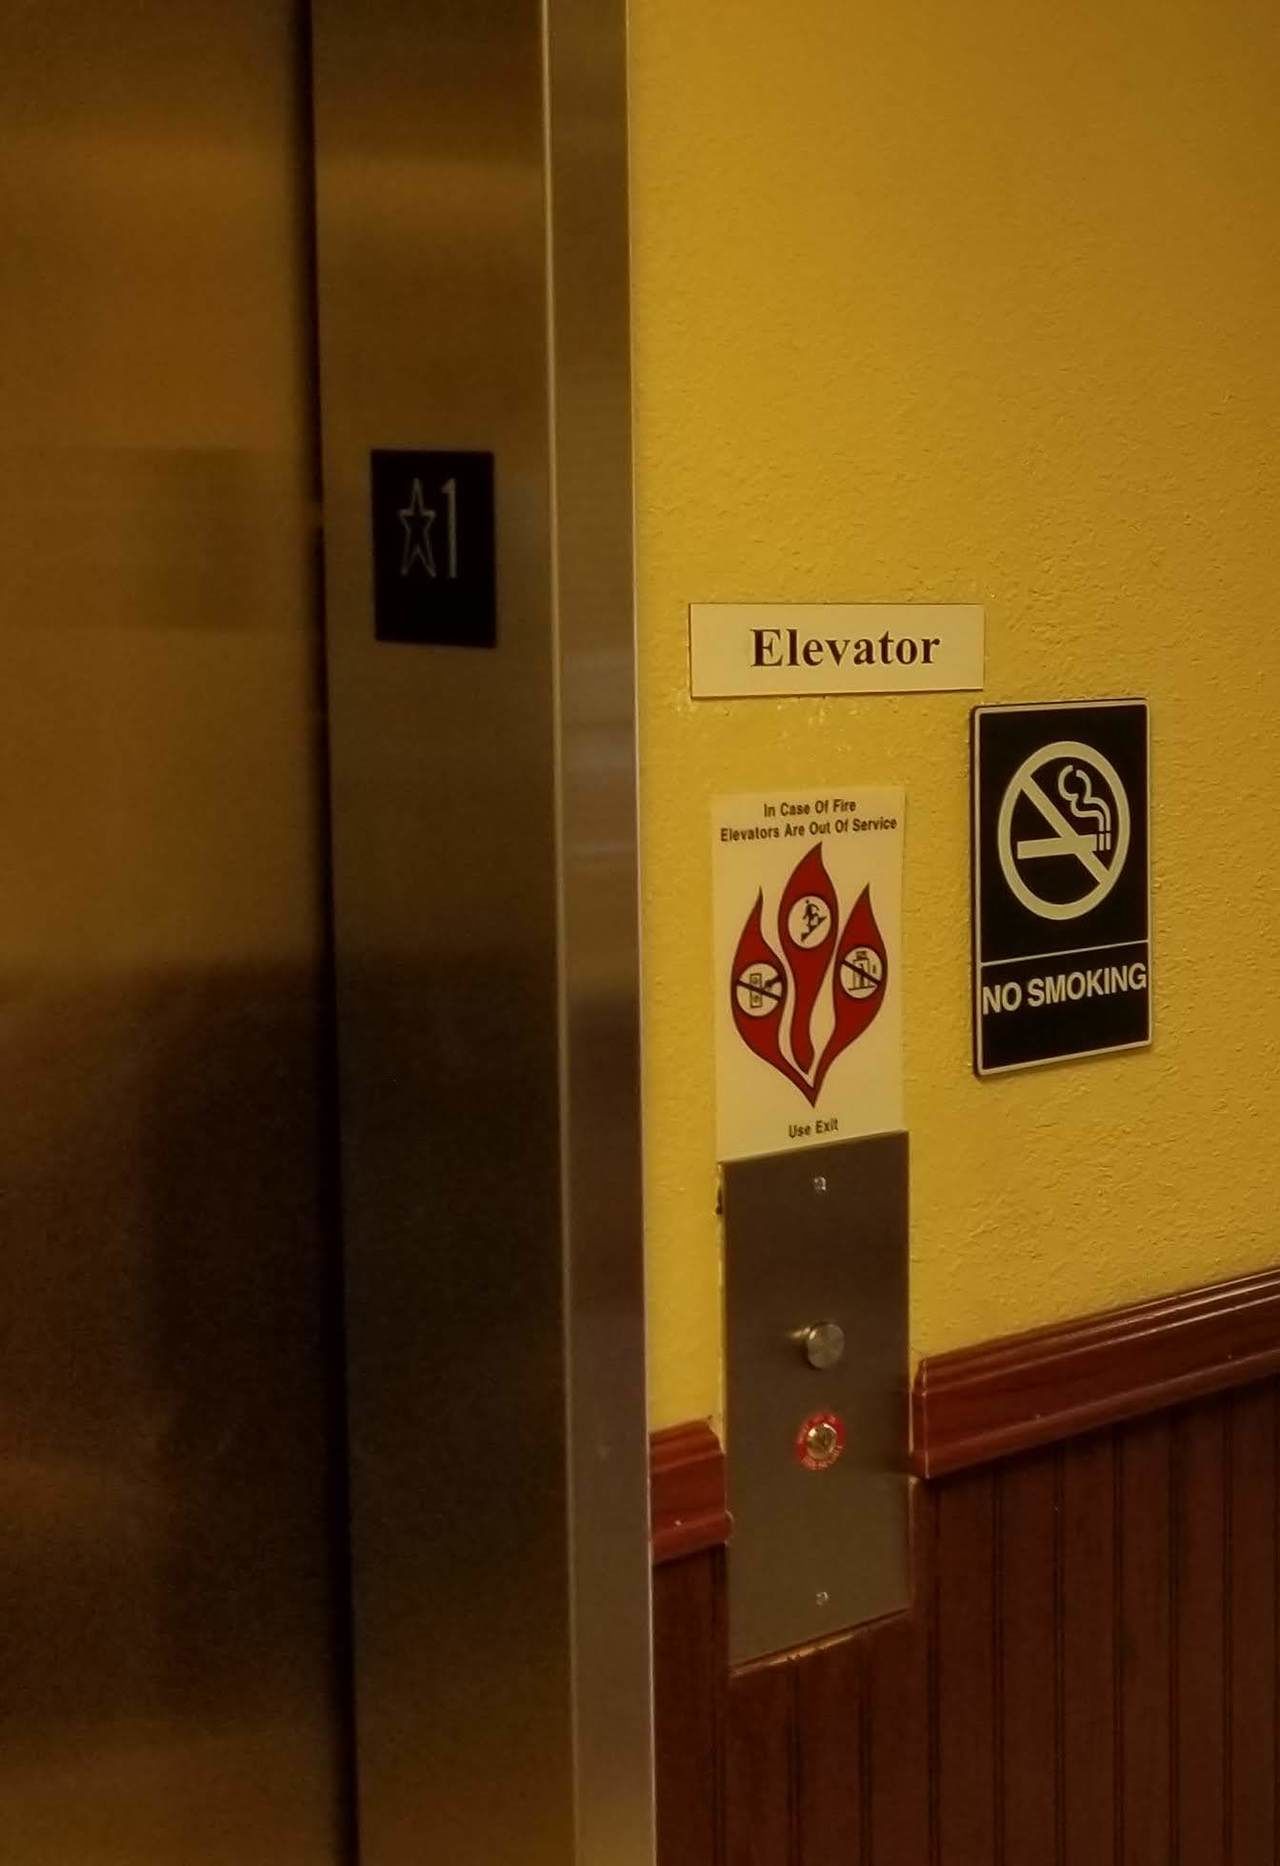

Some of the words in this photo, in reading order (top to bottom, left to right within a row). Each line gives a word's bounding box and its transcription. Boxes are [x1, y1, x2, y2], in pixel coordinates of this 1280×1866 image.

[750, 628, 941, 667] Elevator
[763, 803, 776, 817] In
[780, 801, 811, 817] Case
[815, 800, 829, 814] Of
[833, 798, 857, 813] Fire
[720, 826, 781, 842] Elevators
[784, 822, 806, 837] Are
[809, 821, 832, 836] Out
[835, 818, 849, 833] Of
[852, 815, 898, 832] Service
[982, 981, 1023, 1016] NO
[1027, 962, 1148, 1007] SMOKING
[788, 1124, 812, 1140] Use
[815, 1117, 839, 1134] Exit
